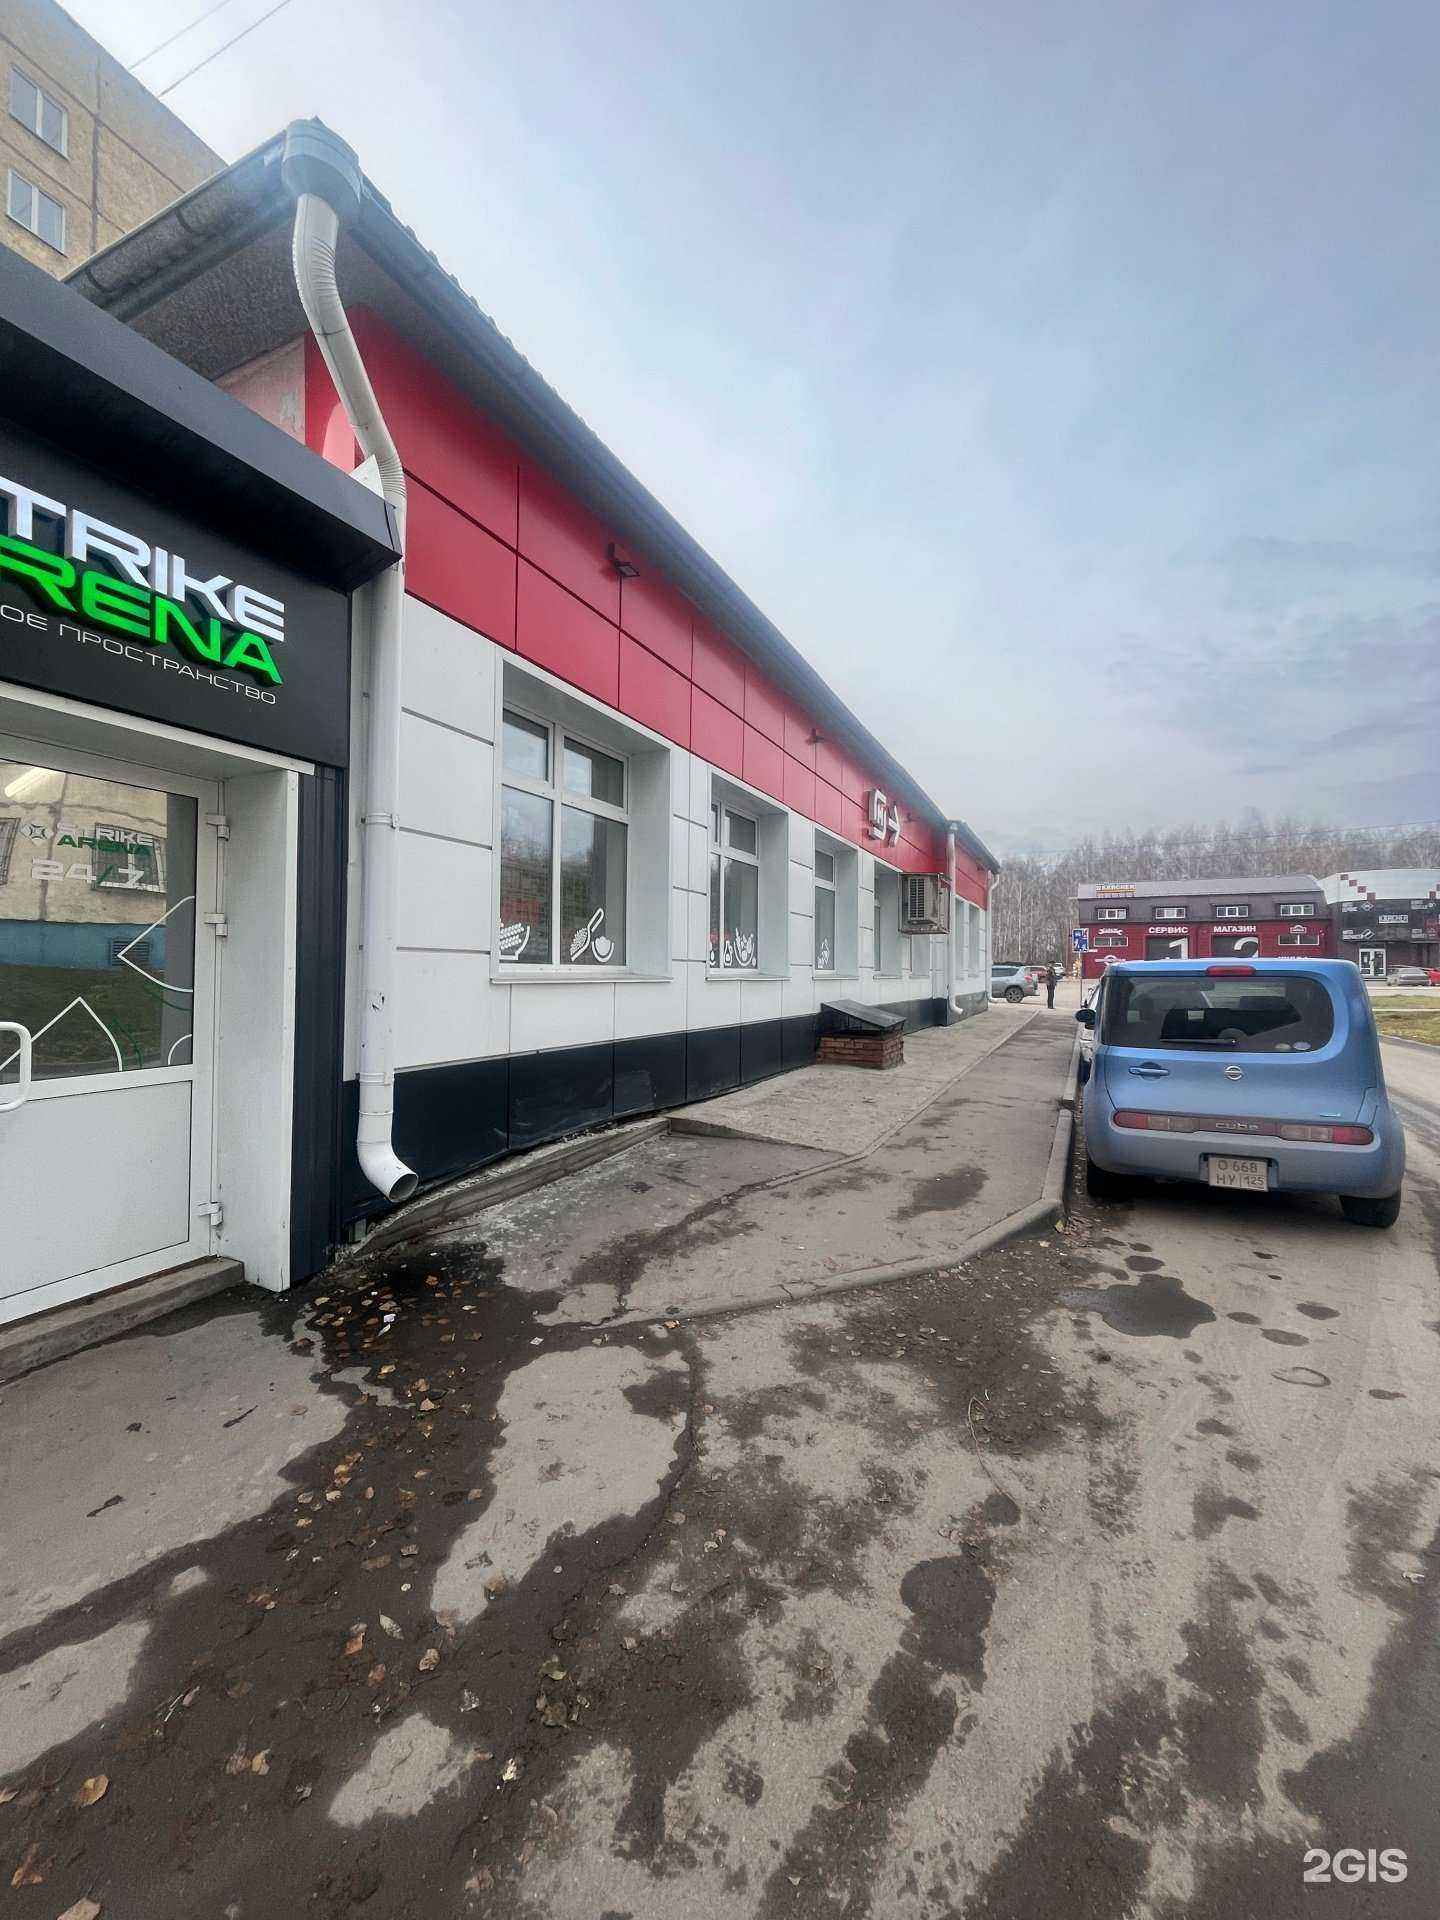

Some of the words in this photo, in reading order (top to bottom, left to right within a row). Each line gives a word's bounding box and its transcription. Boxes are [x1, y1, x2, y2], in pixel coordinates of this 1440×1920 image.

[59, 623, 276, 705] ПРОСТРАНСТВО
[1148, 926, 1189, 934] СЕРВИС
[1213, 925, 1257, 933] МАГАЗИН
